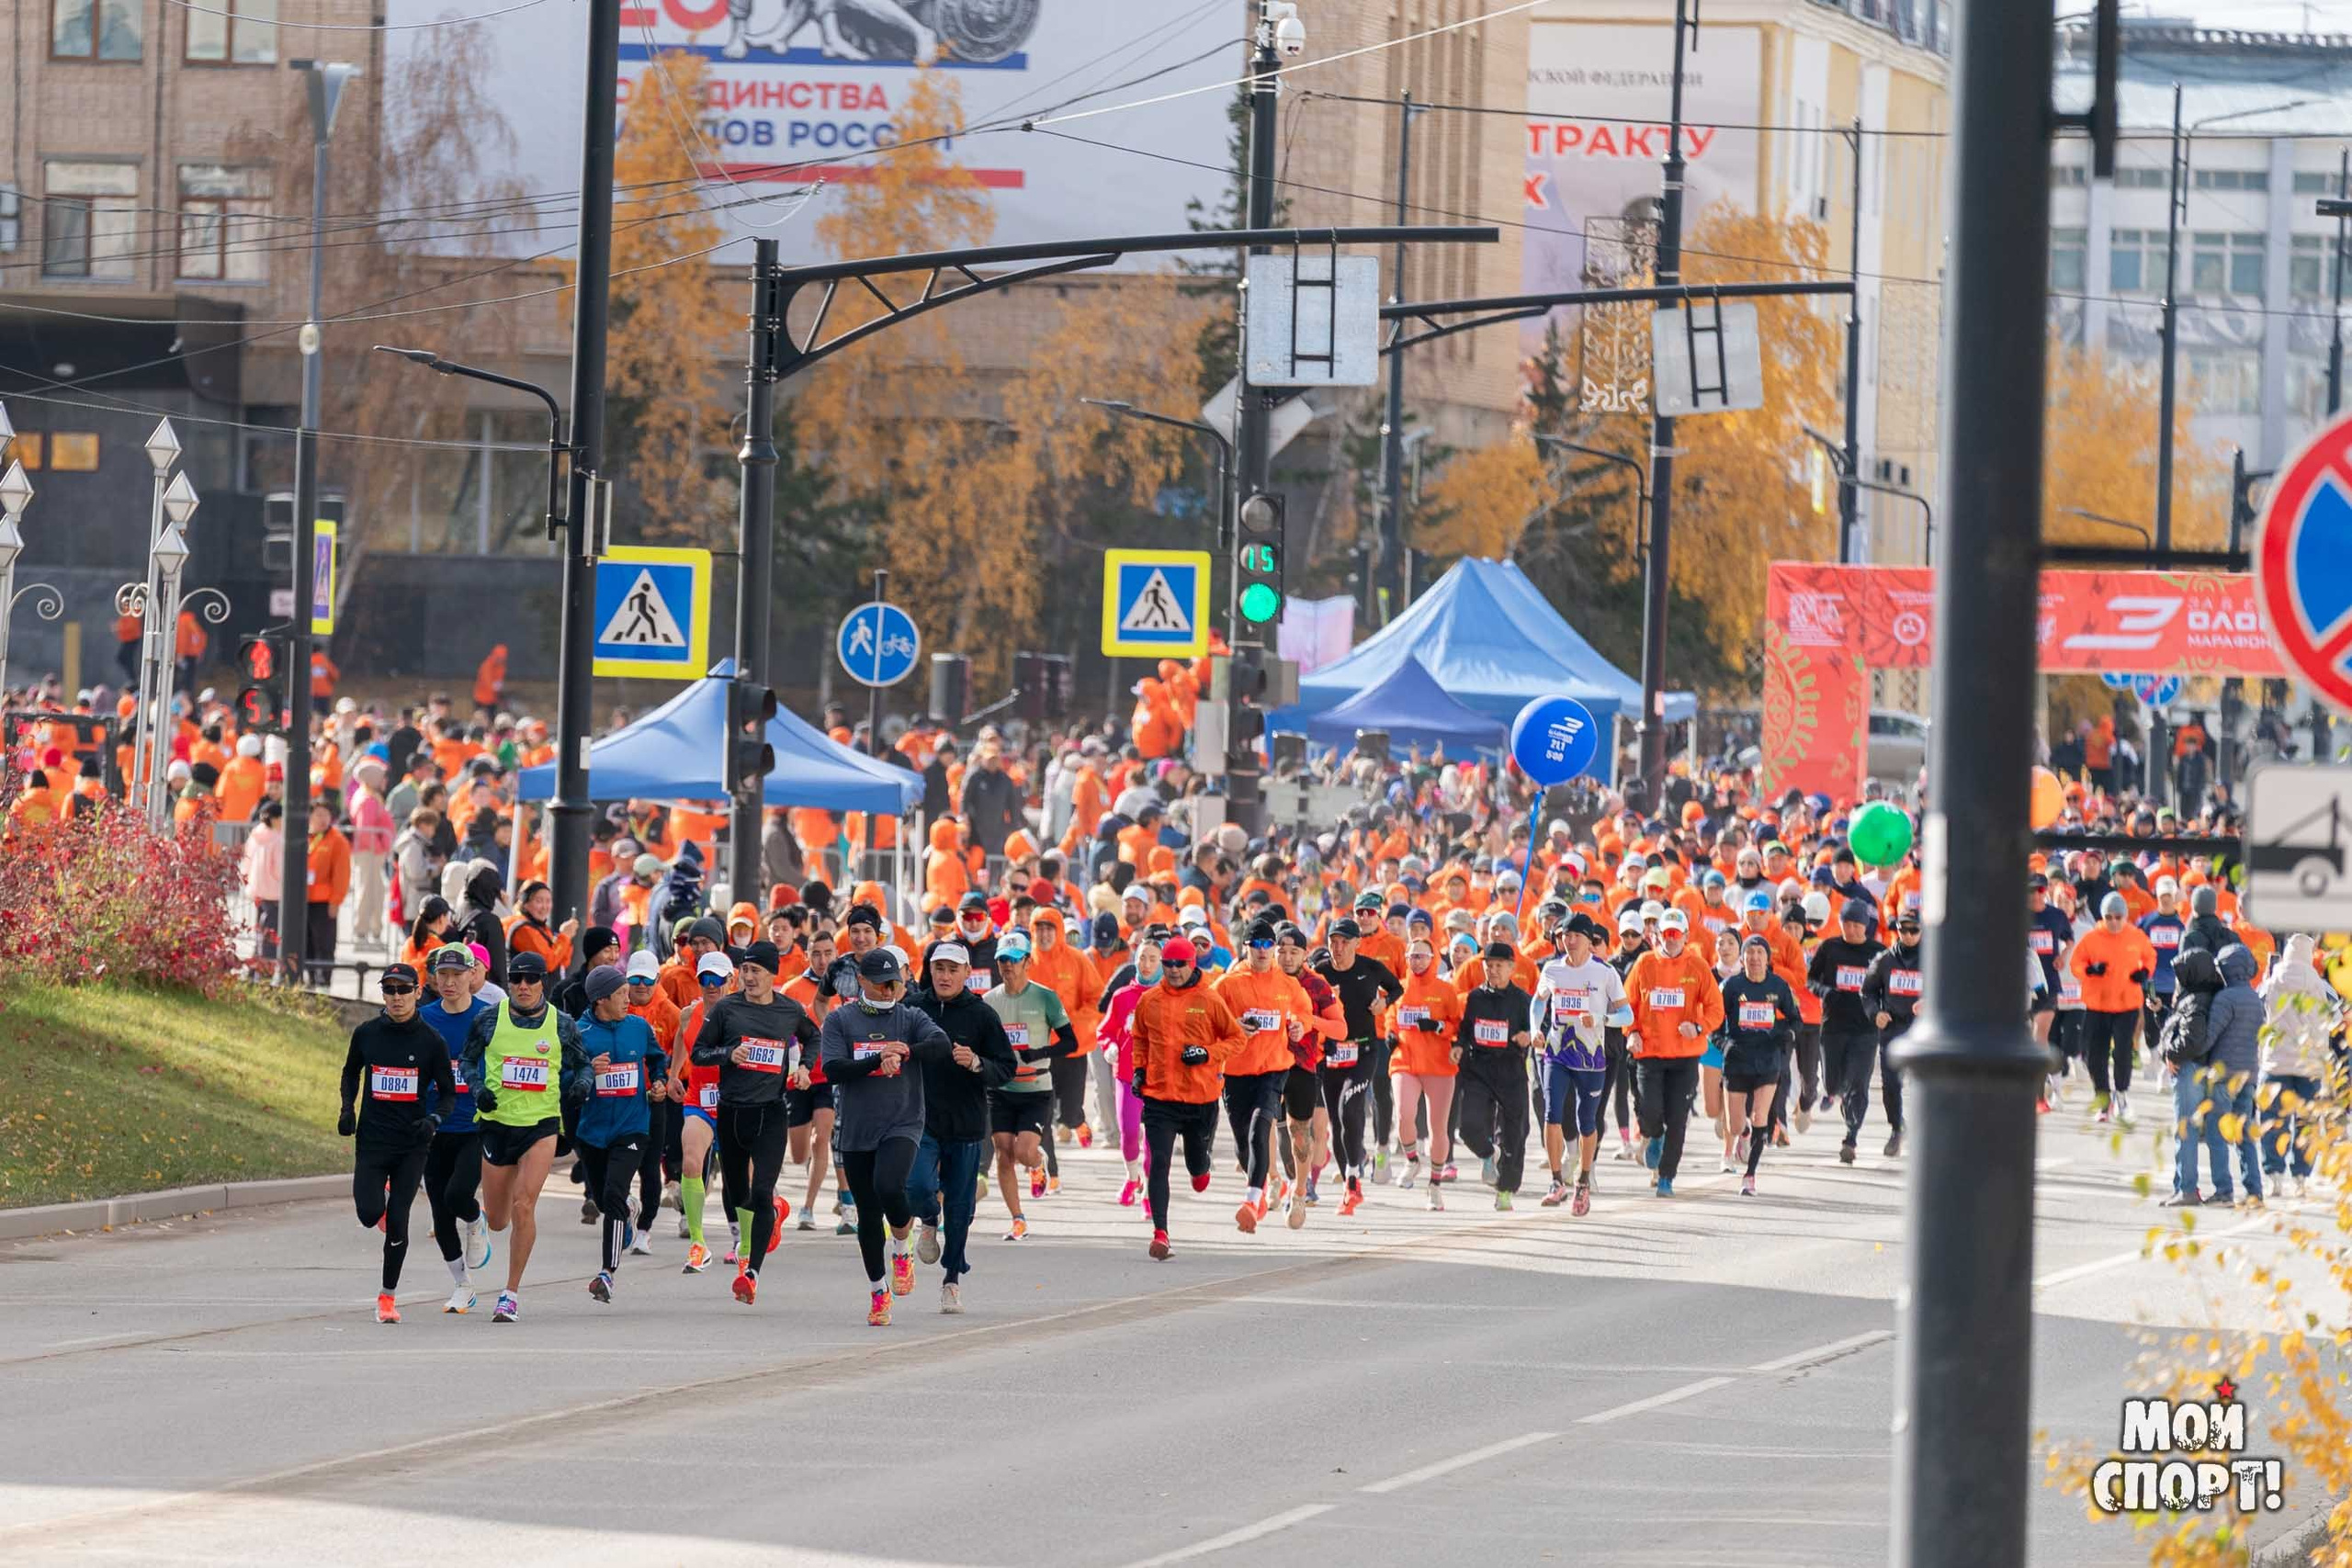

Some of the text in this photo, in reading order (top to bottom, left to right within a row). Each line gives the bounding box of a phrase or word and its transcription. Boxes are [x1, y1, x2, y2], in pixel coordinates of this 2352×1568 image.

[694, 80, 889, 111] ДИНСТВА
[1248, 545, 1274, 573] 15
[1561, 997, 1582, 1009] 0936
[1256, 1016, 1274, 1029] 664
[749, 1047, 775, 1063] 0683
[514, 1066, 539, 1082] 1474
[605, 1073, 631, 1088] 0667
[381, 1077, 408, 1091] 0884
